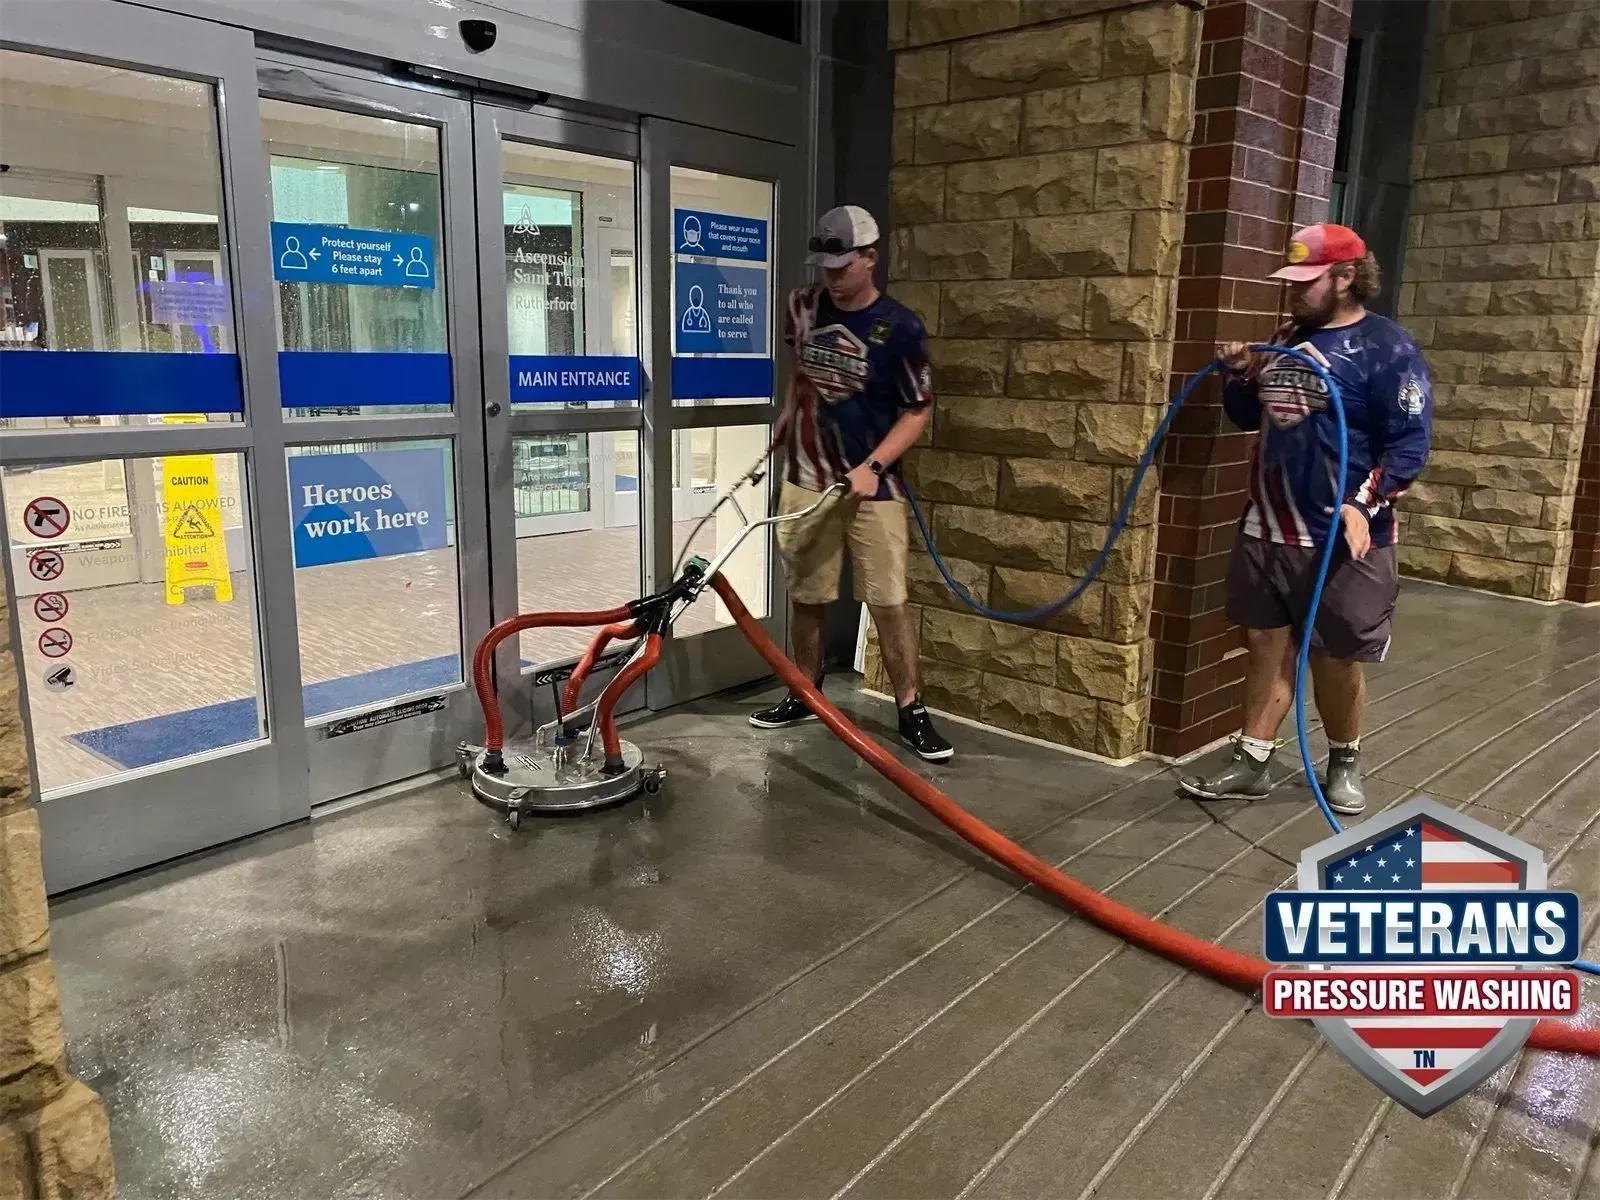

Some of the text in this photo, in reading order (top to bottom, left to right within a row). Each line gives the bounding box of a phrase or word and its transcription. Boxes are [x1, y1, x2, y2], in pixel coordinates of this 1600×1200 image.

[710, 221, 728, 231] Please
[745, 227, 759, 235] mask
[321, 236, 391, 252] Protect yourself
[708, 231, 719, 240] that
[719, 233, 737, 242] covers
[737, 236, 748, 244] your
[333, 251, 383, 265] Please stay
[514, 247, 585, 268] Ascension
[331, 264, 383, 277] 6 feet apart
[514, 268, 592, 289] Saint Thom
[718, 284, 758, 298] Thank you
[515, 295, 577, 311] Rutherford
[718, 300, 754, 310] to all who
[718, 315, 754, 324] are called
[718, 329, 748, 339] to serve
[518, 371, 630, 387] MAIN ENTRANCE
[171, 476, 209, 486] CAUTION
[302, 483, 393, 508] Heroes
[72, 507, 95, 522] NO
[99, 501, 169, 519] FIRERMS
[173, 496, 236, 513] ALLOWED
[304, 508, 430, 539] work here
[145, 543, 208, 560] Pohibited
